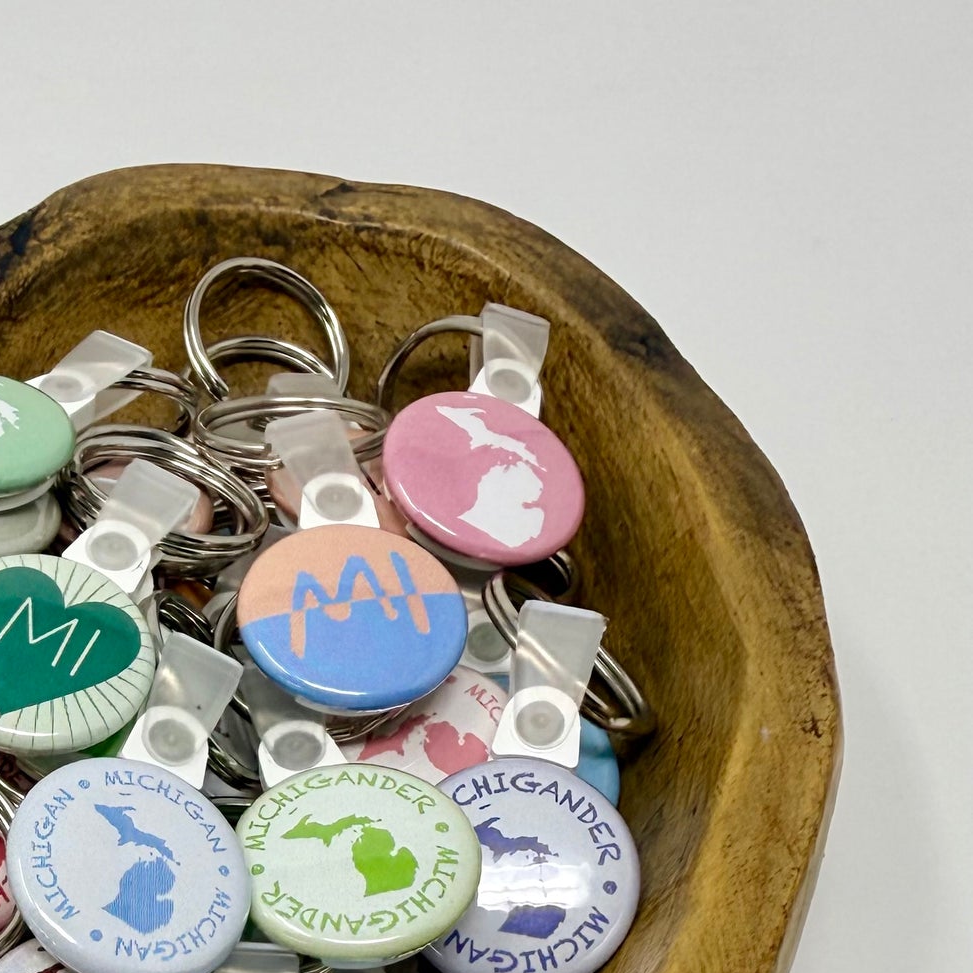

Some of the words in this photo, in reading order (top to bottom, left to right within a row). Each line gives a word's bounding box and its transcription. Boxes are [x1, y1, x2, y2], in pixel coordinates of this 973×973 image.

[289, 551, 431, 659] MI
[31, 788, 81, 921] MICHIGAN
[105, 770, 227, 853] MICHIGAN
[245, 770, 436, 851] MICHIGANDER
[452, 772, 621, 866] CHIGANDER
[115, 887, 232, 962] MICHIGAN
[261, 845, 460, 935] MICHIGANDER
